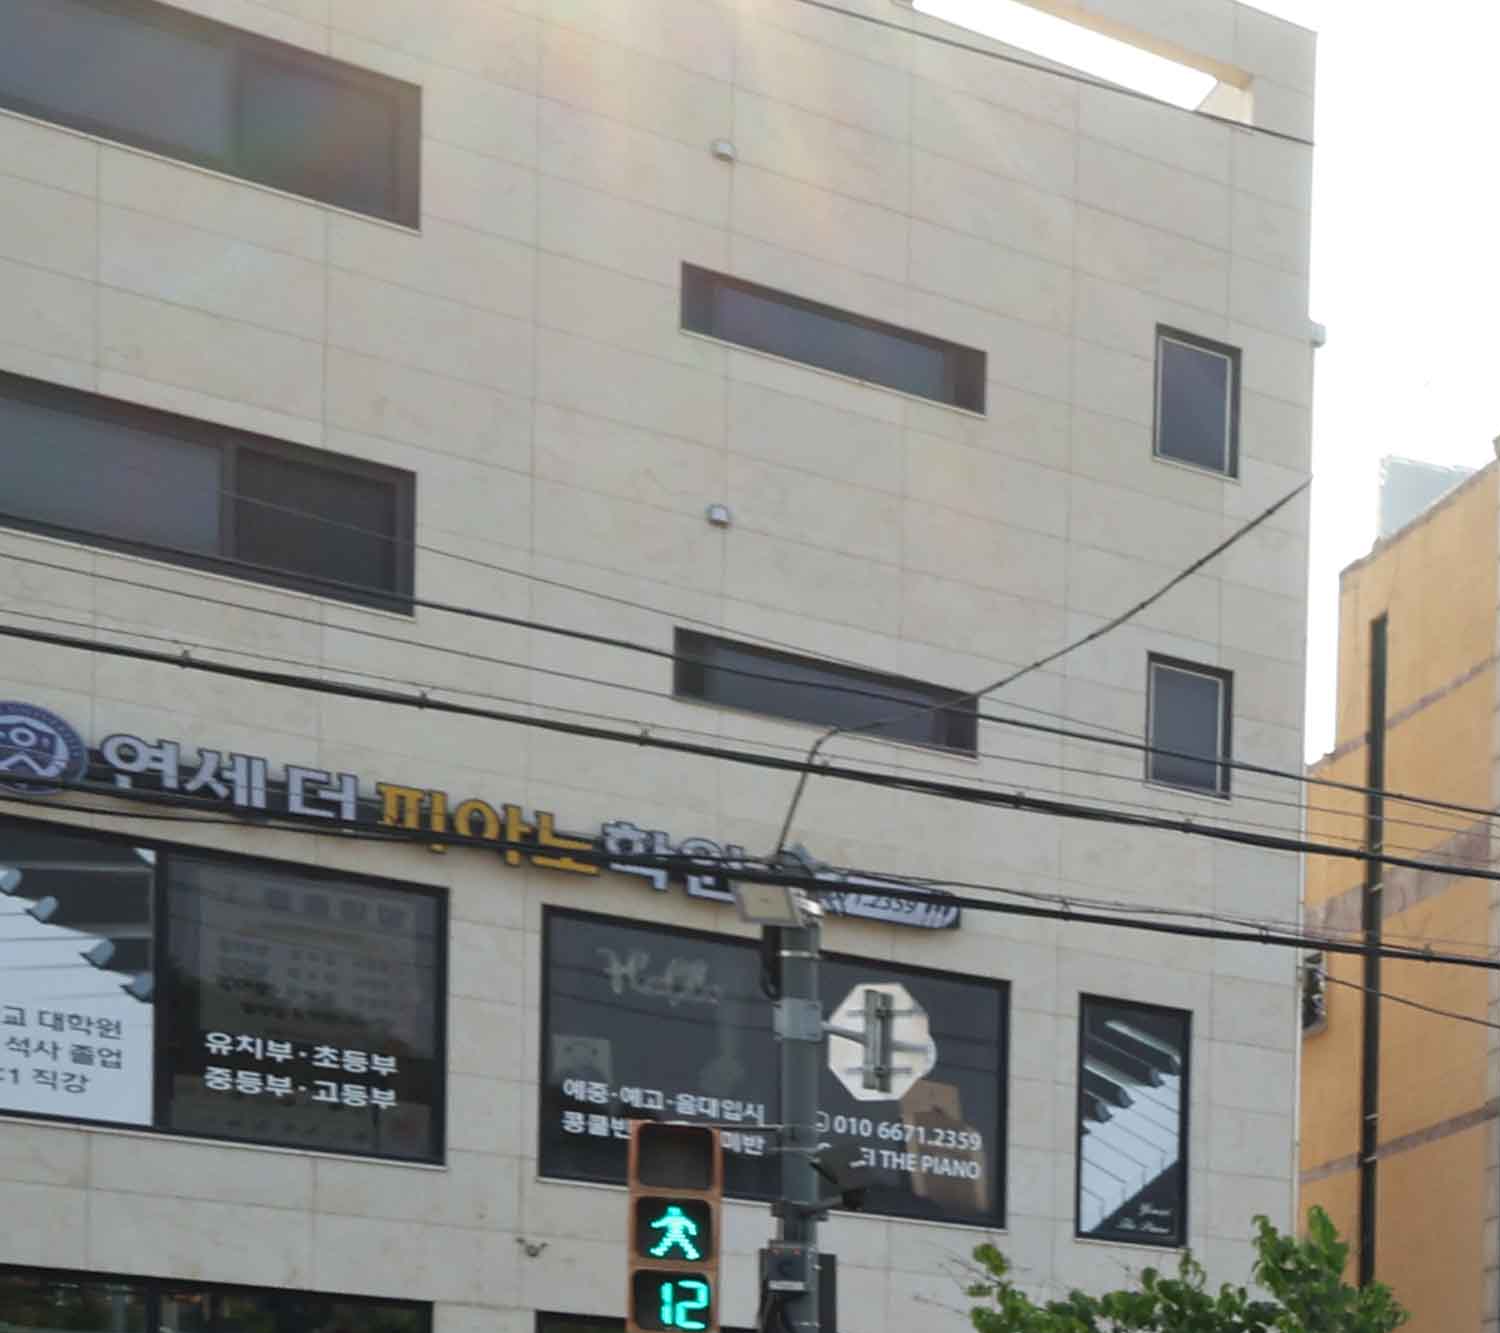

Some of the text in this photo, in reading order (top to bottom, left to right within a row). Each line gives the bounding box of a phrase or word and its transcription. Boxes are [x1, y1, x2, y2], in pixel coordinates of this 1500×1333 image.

[376, 781, 599, 874] 피아노
[37, 1010, 123, 1040] 대학원
[70, 1044, 123, 1070] 졸업
[33, 1068, 89, 1094] 직강
[834, 1113, 982, 1151] 010 6671.2359
[879, 1150, 917, 1173] THE
[919, 1155, 982, 1180] PIANO
[659, 1280, 710, 1330] 12
